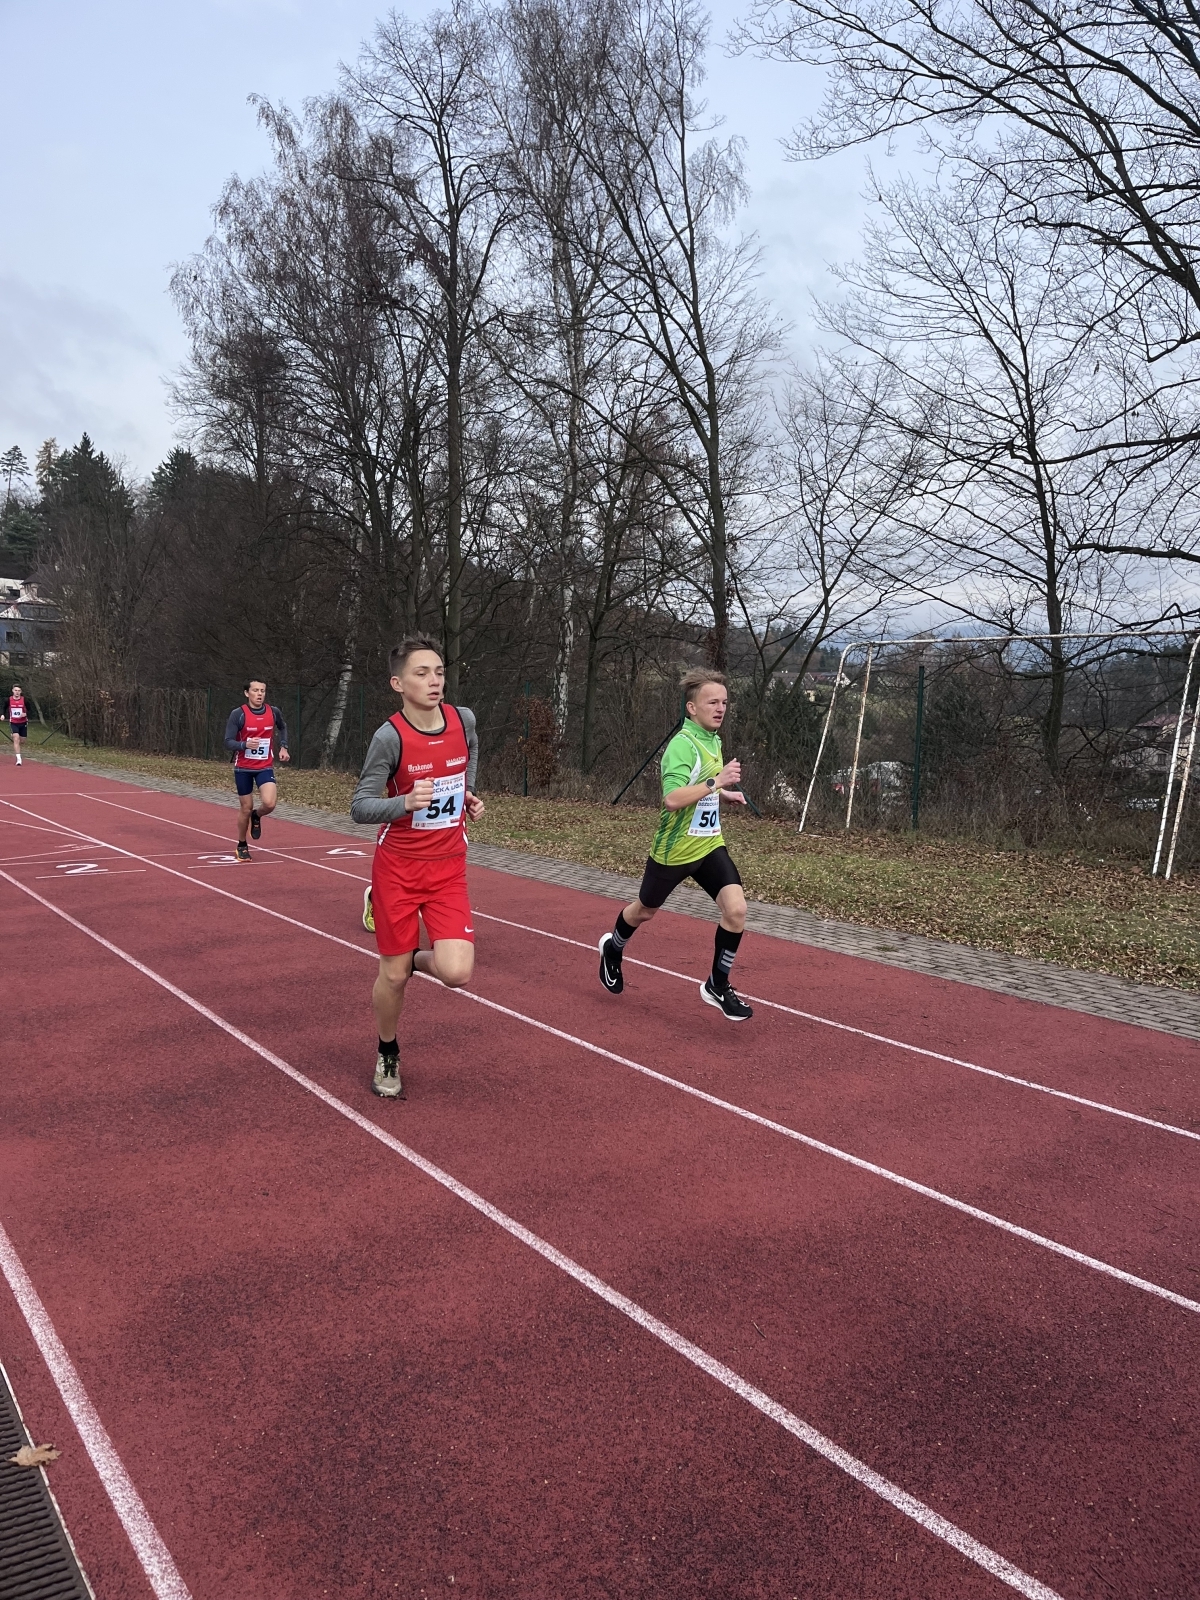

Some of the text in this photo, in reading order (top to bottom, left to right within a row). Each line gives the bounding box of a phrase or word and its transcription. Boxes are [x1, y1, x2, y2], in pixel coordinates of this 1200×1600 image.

[426, 796, 456, 819] 54
[699, 811, 717, 827] 50
[197, 855, 240, 864] 3
[56, 863, 109, 874] 2
